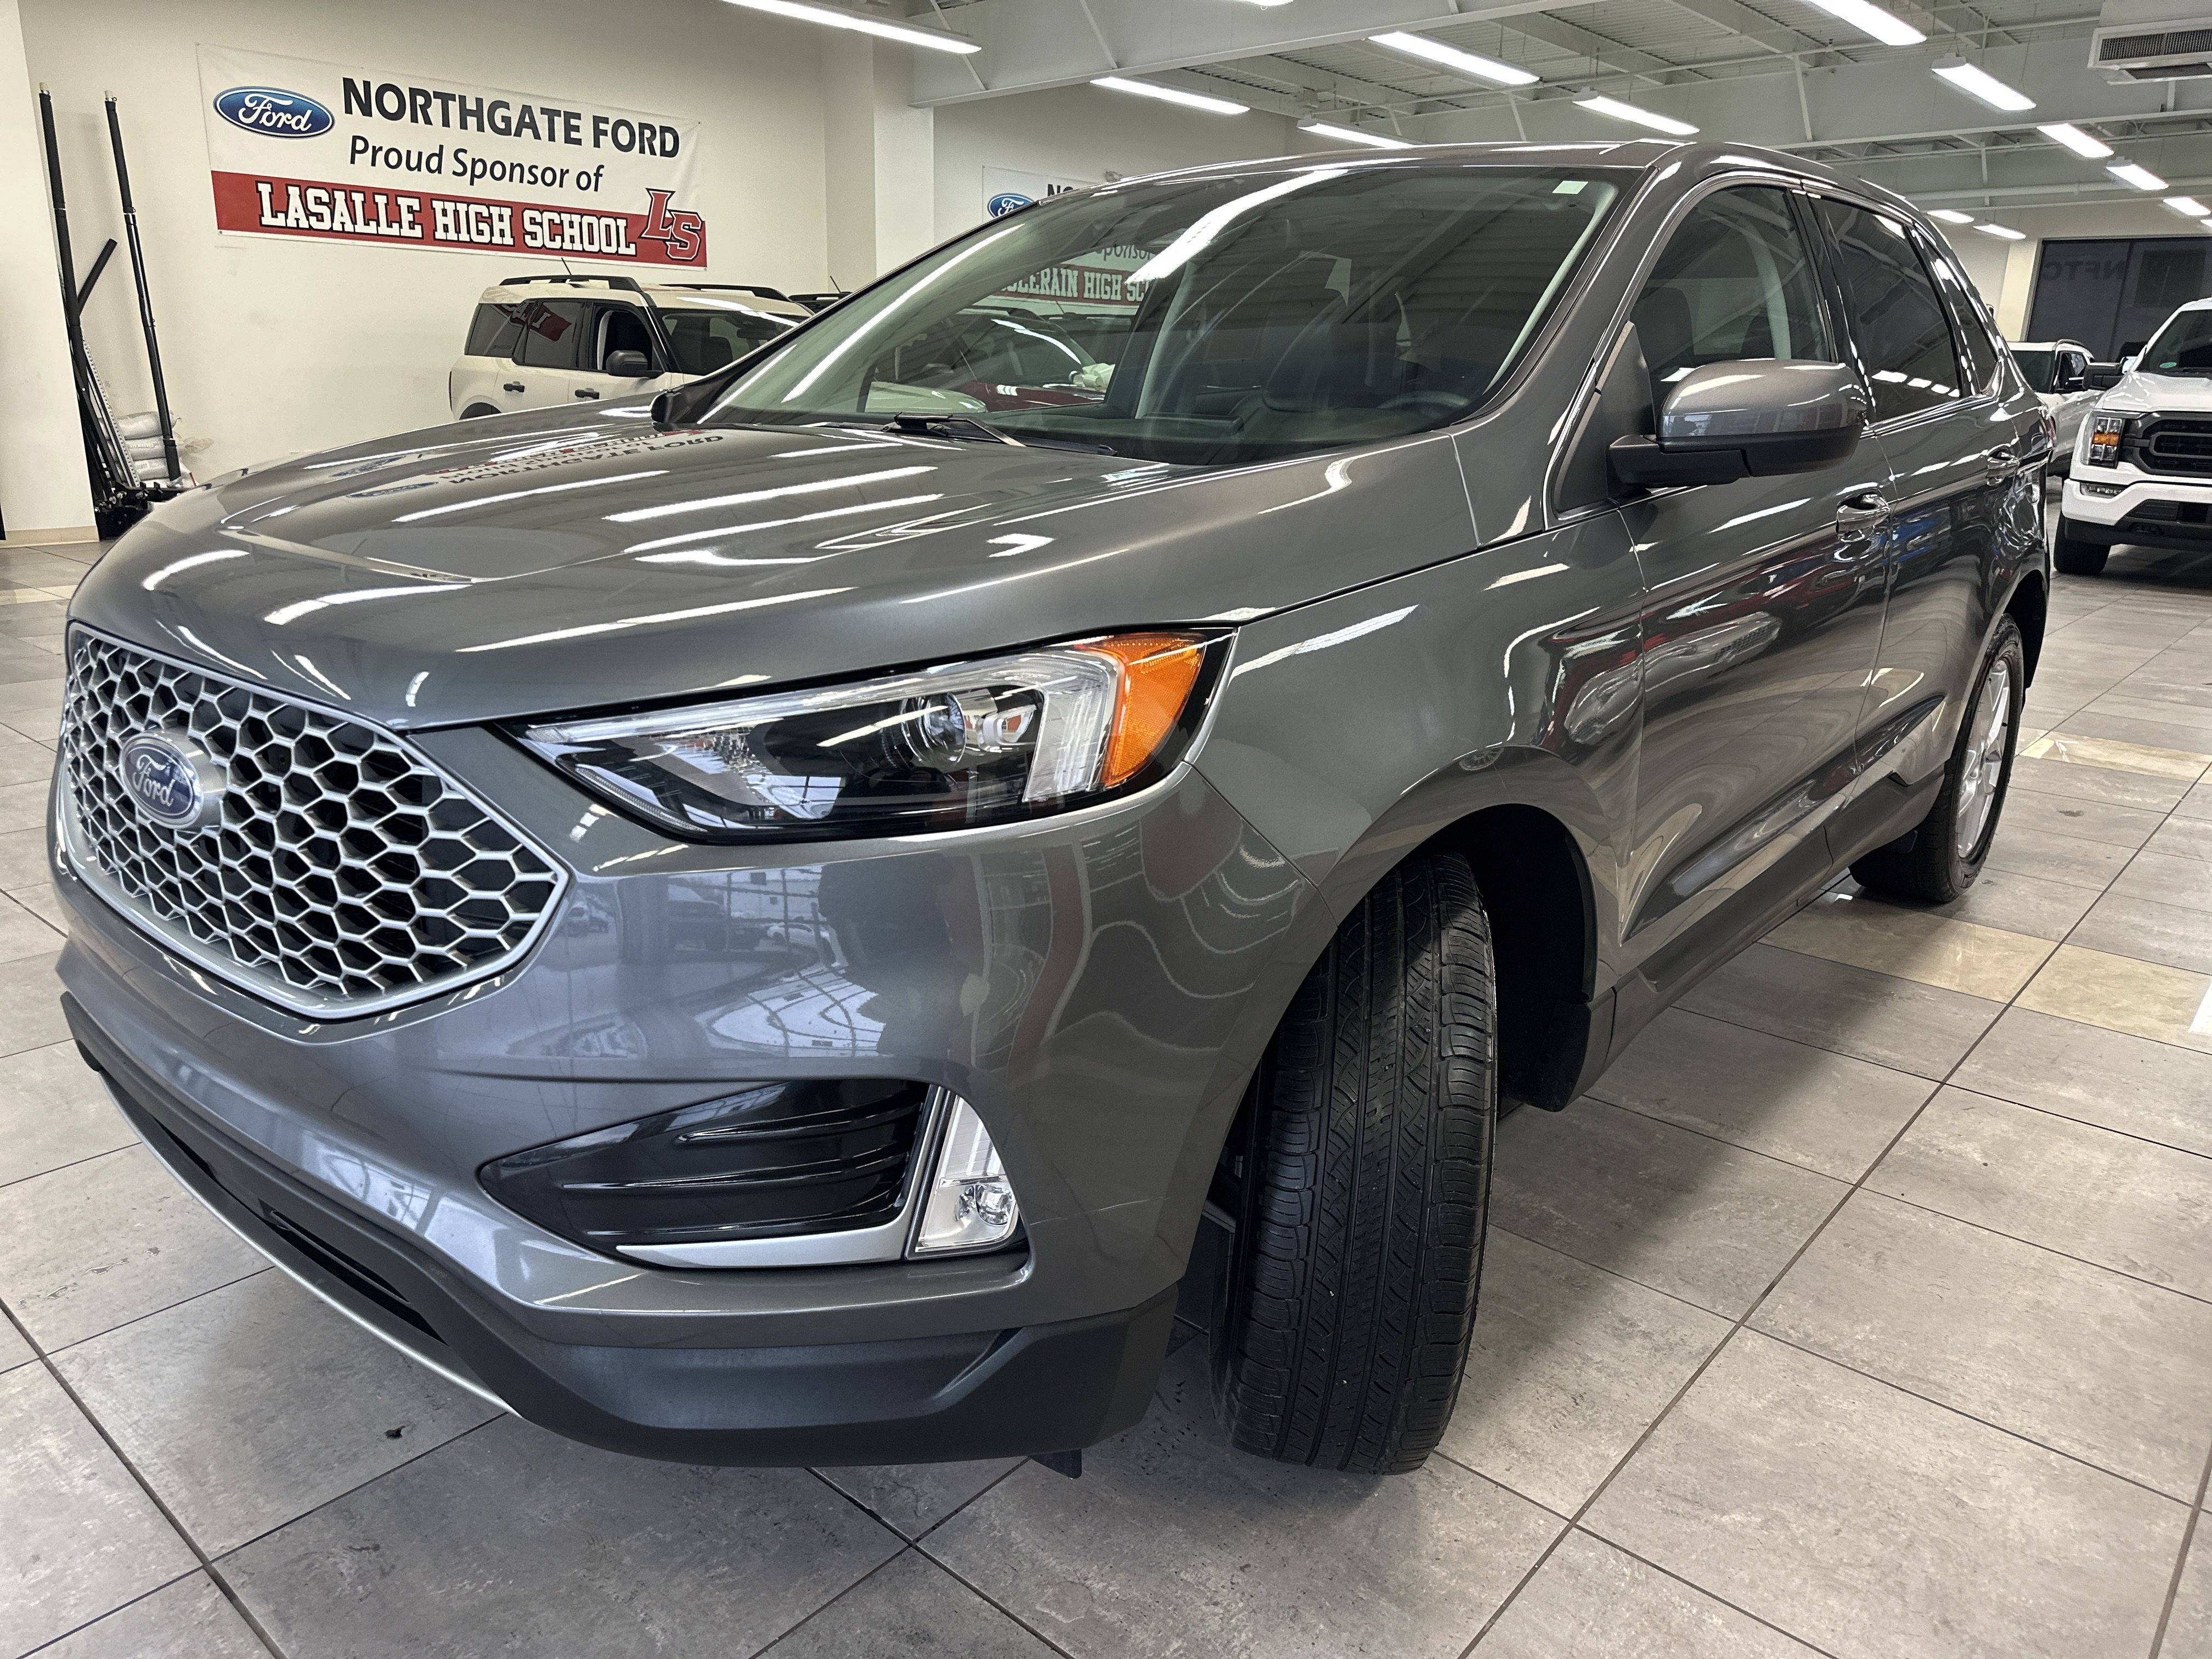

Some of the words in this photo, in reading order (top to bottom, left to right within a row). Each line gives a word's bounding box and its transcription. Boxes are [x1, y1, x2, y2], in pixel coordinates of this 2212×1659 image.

[238, 93, 313, 132] Ford
[342, 77, 582, 146] NORTHGATE
[592, 115, 680, 158] FORD
[350, 135, 444, 174] Proud
[452, 148, 569, 188] Sponsor
[576, 165, 605, 192] of
[255, 181, 424, 239] LASALLE
[431, 199, 514, 246] HIGH
[523, 208, 636, 256] SCHOOL
[637, 188, 702, 261] LS
[1001, 267, 1079, 298] LERAIN
[1084, 272, 1123, 301] HIGH
[132, 754, 176, 806] Ford
